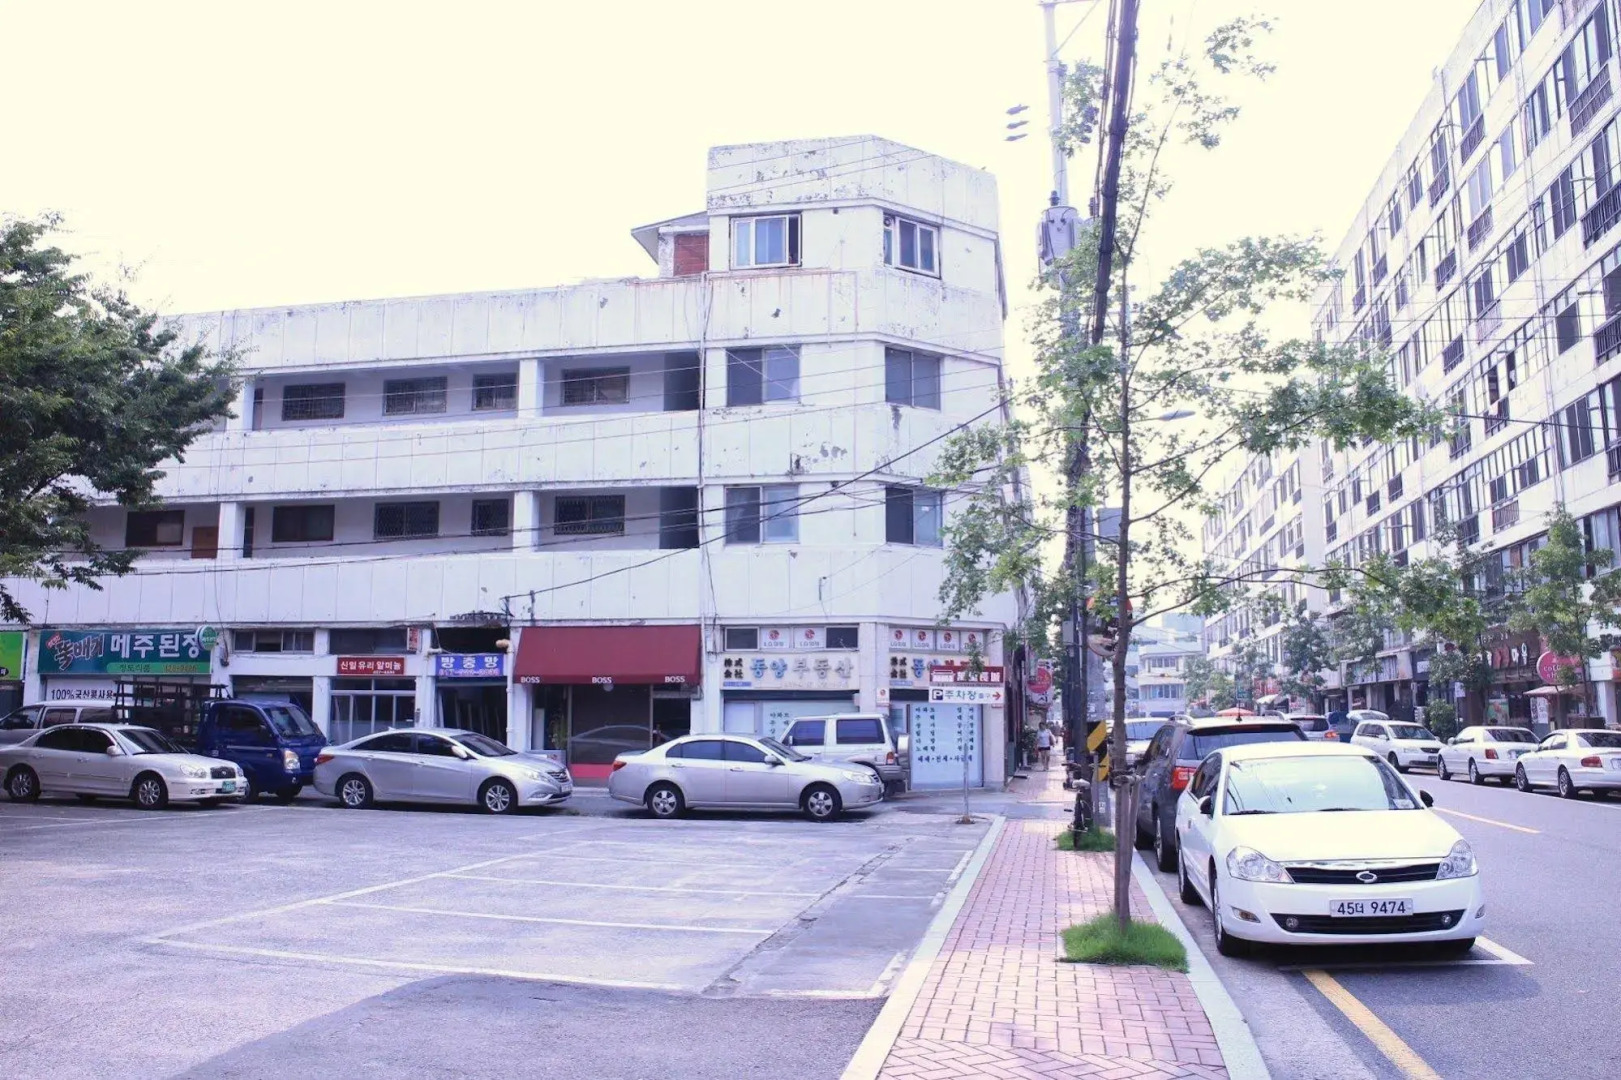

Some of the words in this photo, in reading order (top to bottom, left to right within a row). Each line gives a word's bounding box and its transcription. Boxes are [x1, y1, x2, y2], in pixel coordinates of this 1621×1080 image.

[520, 676, 541, 684] BOSS
[592, 676, 612, 684] BOSS
[664, 675, 685, 683] BOSS
[945, 690, 976, 700] 주차장
[1337, 902, 1364, 915] 45더
[1371, 901, 1406, 914] 9474
